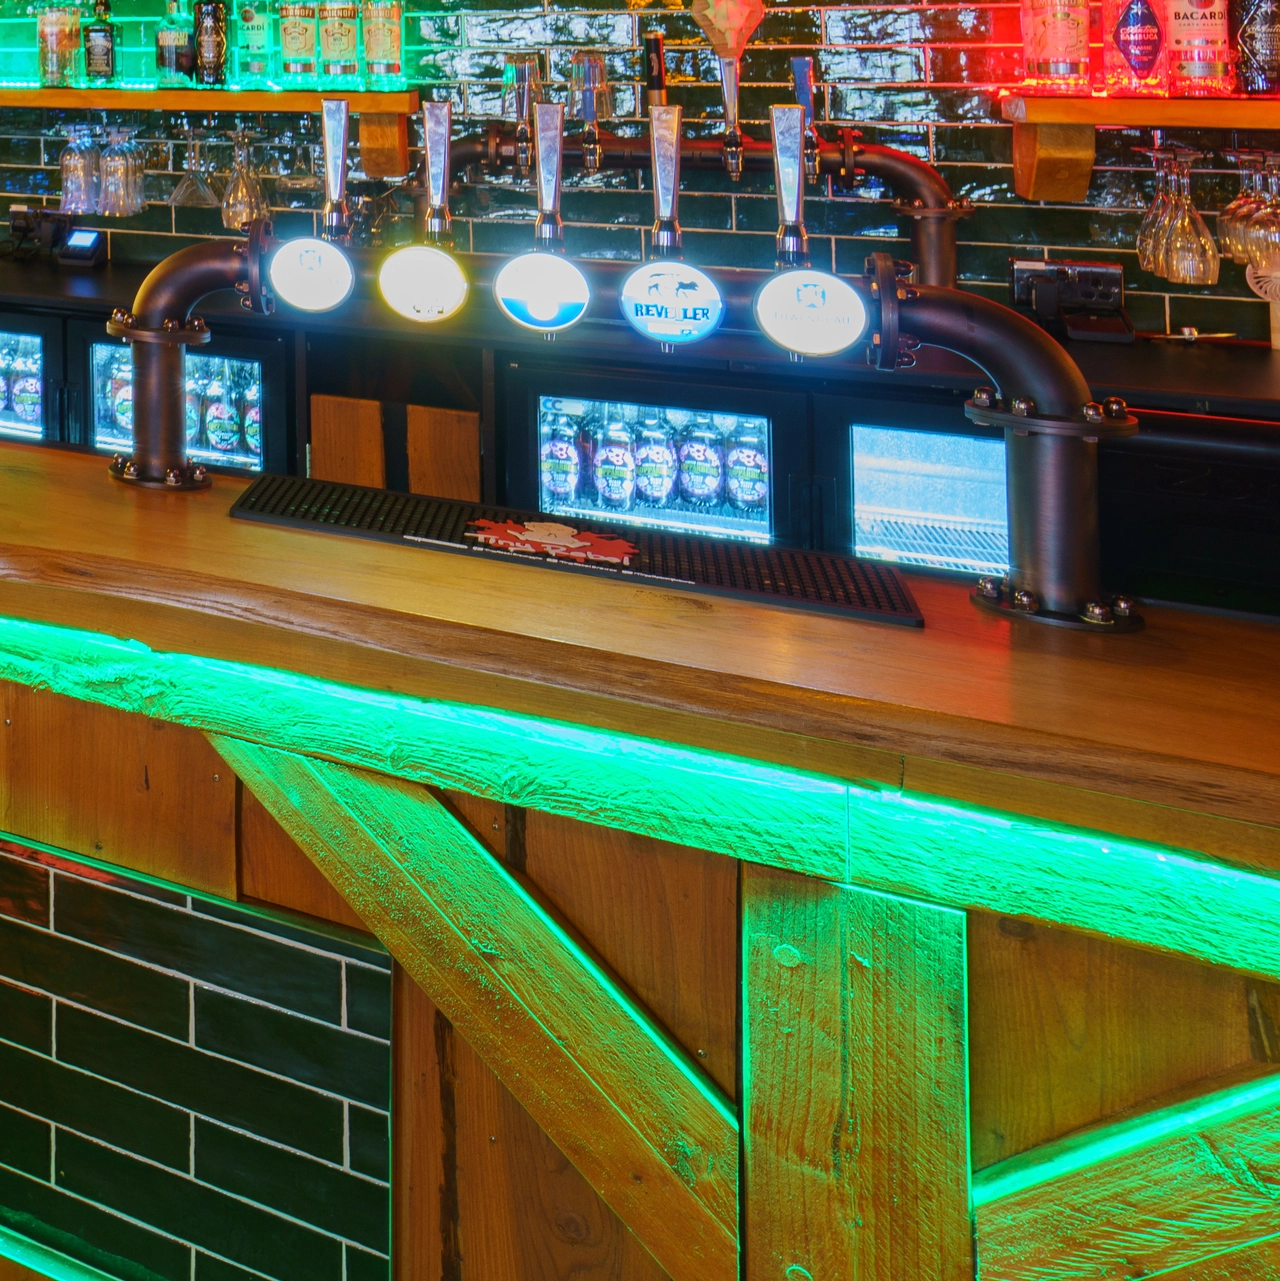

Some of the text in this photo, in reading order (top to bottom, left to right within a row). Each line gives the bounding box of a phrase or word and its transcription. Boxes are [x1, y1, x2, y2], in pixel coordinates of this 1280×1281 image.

[1174, 8, 1227, 21] BACARDÍ
[1120, 33, 1159, 41] SAMBUCA
[634, 302, 711, 322] REVELLER
[463, 532, 536, 553] Tiny
[540, 543, 631, 566] Rebel
